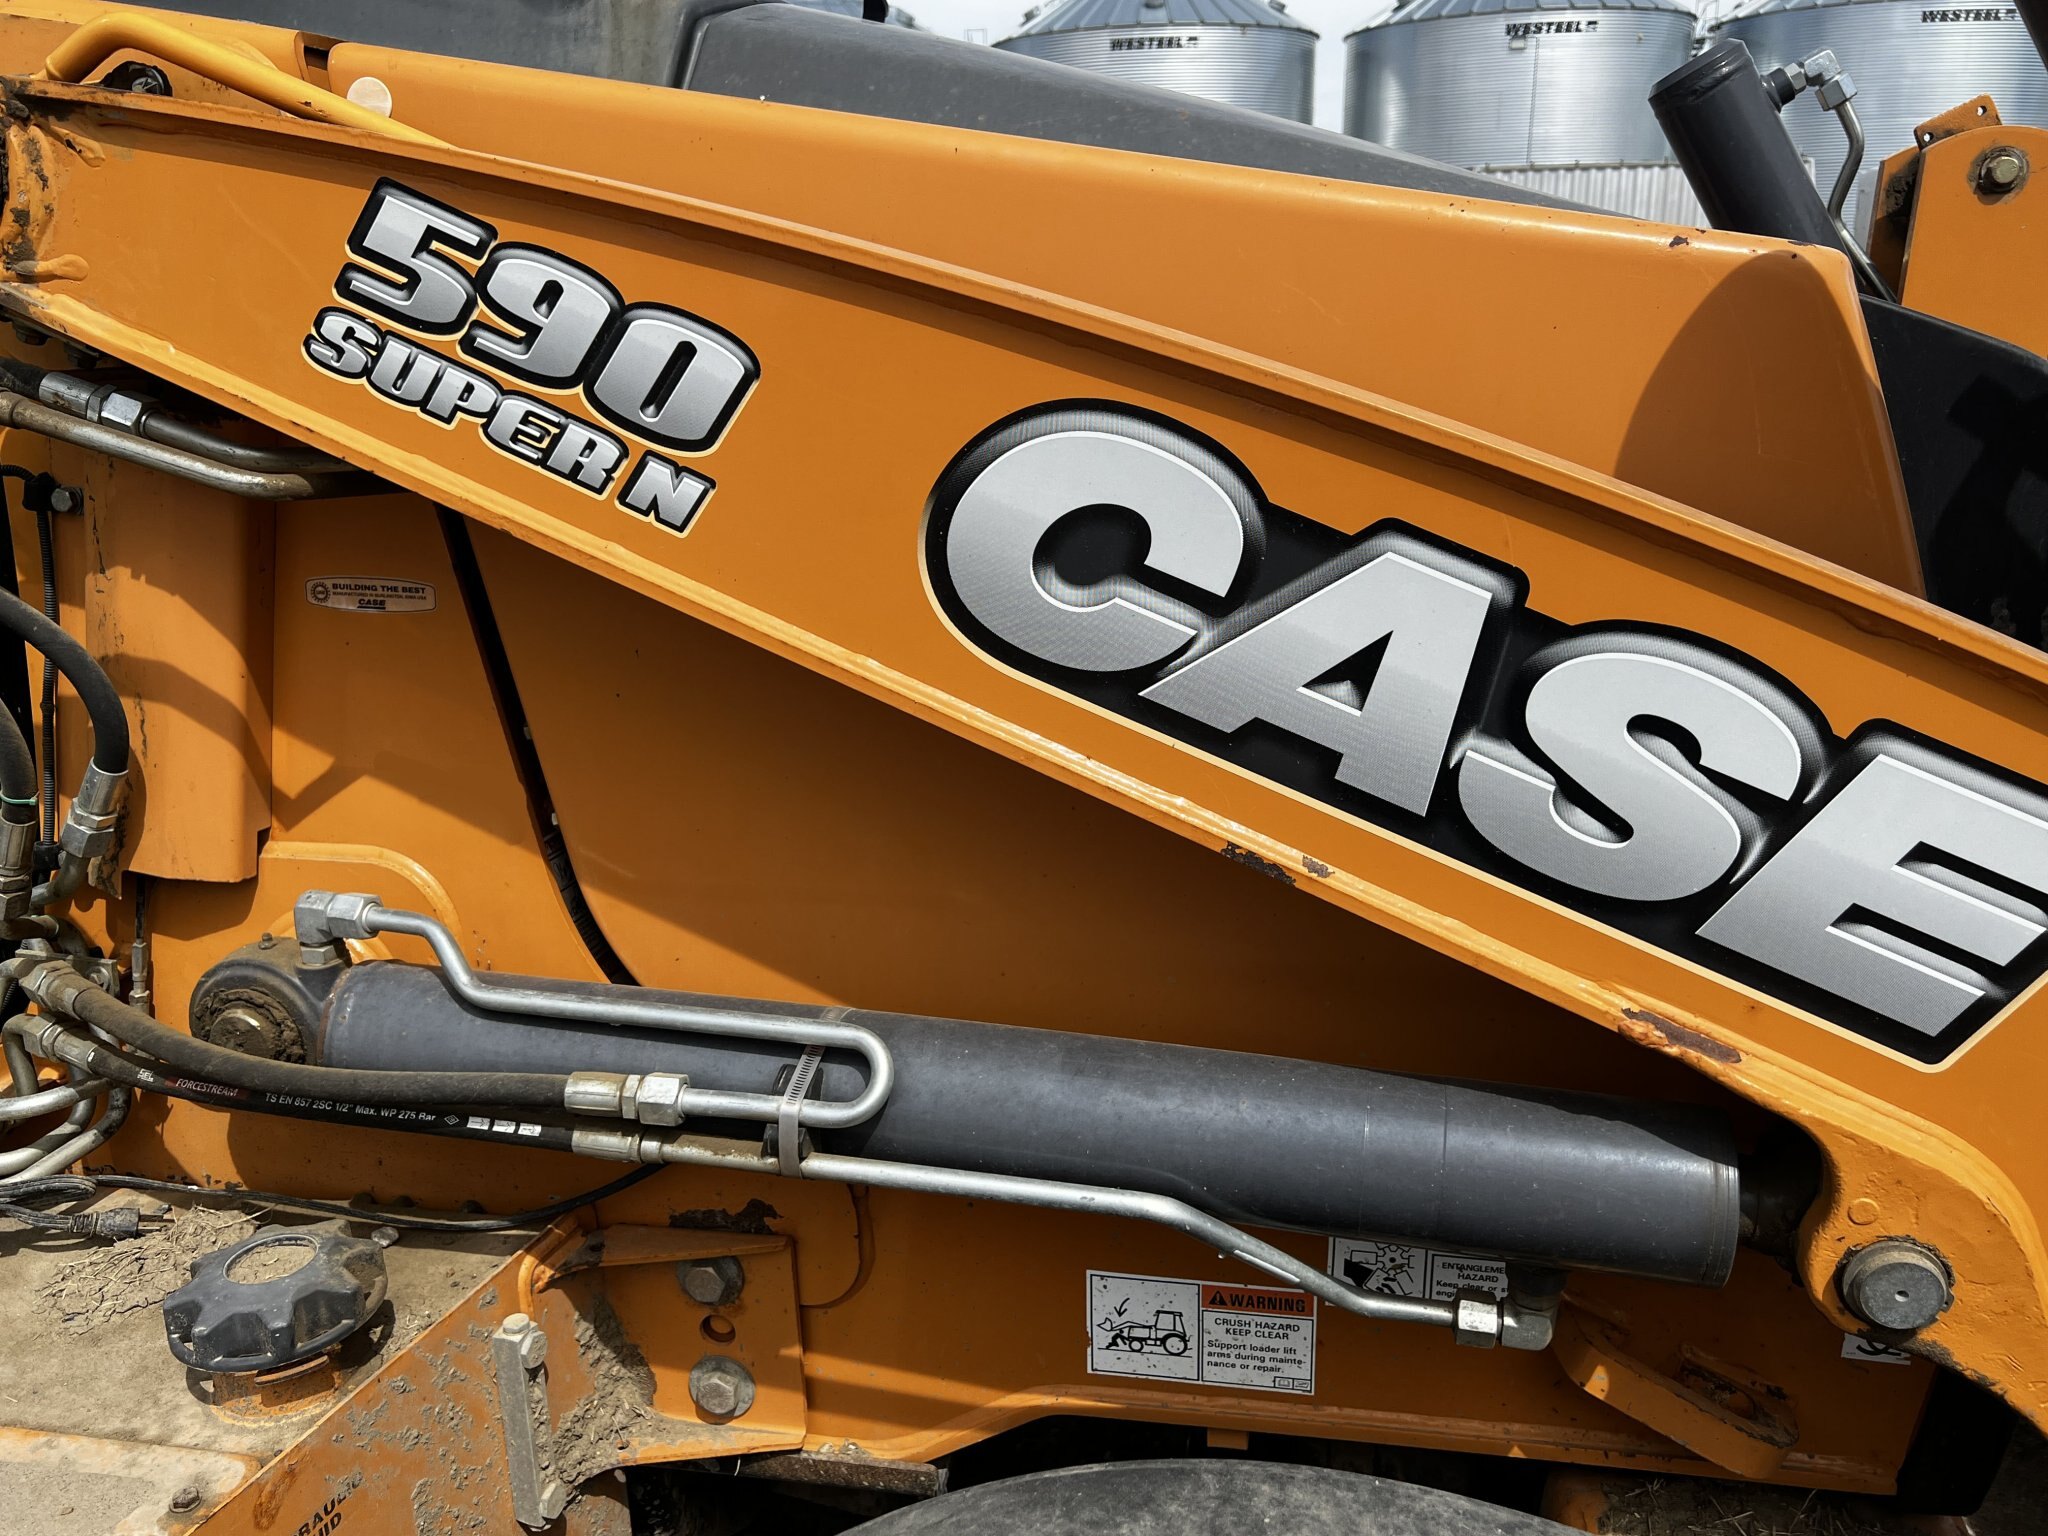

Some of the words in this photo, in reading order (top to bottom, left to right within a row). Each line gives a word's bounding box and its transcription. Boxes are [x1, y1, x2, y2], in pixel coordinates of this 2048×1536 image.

[1921, 9, 2000, 23] WESTEEL
[1505, 21, 1583, 36] WESTEEL
[1109, 36, 1183, 51] WESTEEL
[338, 184, 756, 448] 590
[305, 310, 622, 492] SUPER
[620, 455, 712, 530] N
[332, 583, 378, 592] BUILDING
[380, 585, 399, 593] THE
[402, 586, 426, 594] BEST
[358, 599, 386, 607] CASE
[938, 420, 2048, 1045] CASE
[176, 1078, 239, 1097] FORCESTREAM
[265, 1093, 278, 1103] TS
[279, 1095, 292, 1105] EN
[294, 1097, 312, 1107] 857
[312, 1100, 333, 1110] 2SC
[356, 1105, 378, 1116] Max.
[381, 1108, 397, 1118] WP
[399, 1110, 417, 1120] 275
[418, 1112, 437, 1121] Bar
[1436, 1280, 1459, 1290] Keep
[1462, 1283, 1485, 1292] clear
[1457, 1273, 1500, 1284] HAZARD
[1229, 1293, 1306, 1313] WARNING
[1214, 1317, 1252, 1329] CRUSH
[1254, 1321, 1301, 1333] HAZARD
[1225, 1327, 1252, 1337] KEEP
[1254, 1330, 1290, 1341] CLEAR
[1207, 1340, 1247, 1351] Support
[1249, 1343, 1281, 1354] loader
[1283, 1346, 1298, 1356] lift
[1207, 1350, 1232, 1359] arms
[1234, 1352, 1267, 1364] during
[1269, 1355, 1308, 1366] mainte-
[1206, 1360, 1237, 1369] nance
[1239, 1362, 1251, 1370] or
[1253, 1364, 1286, 1374] repair.
